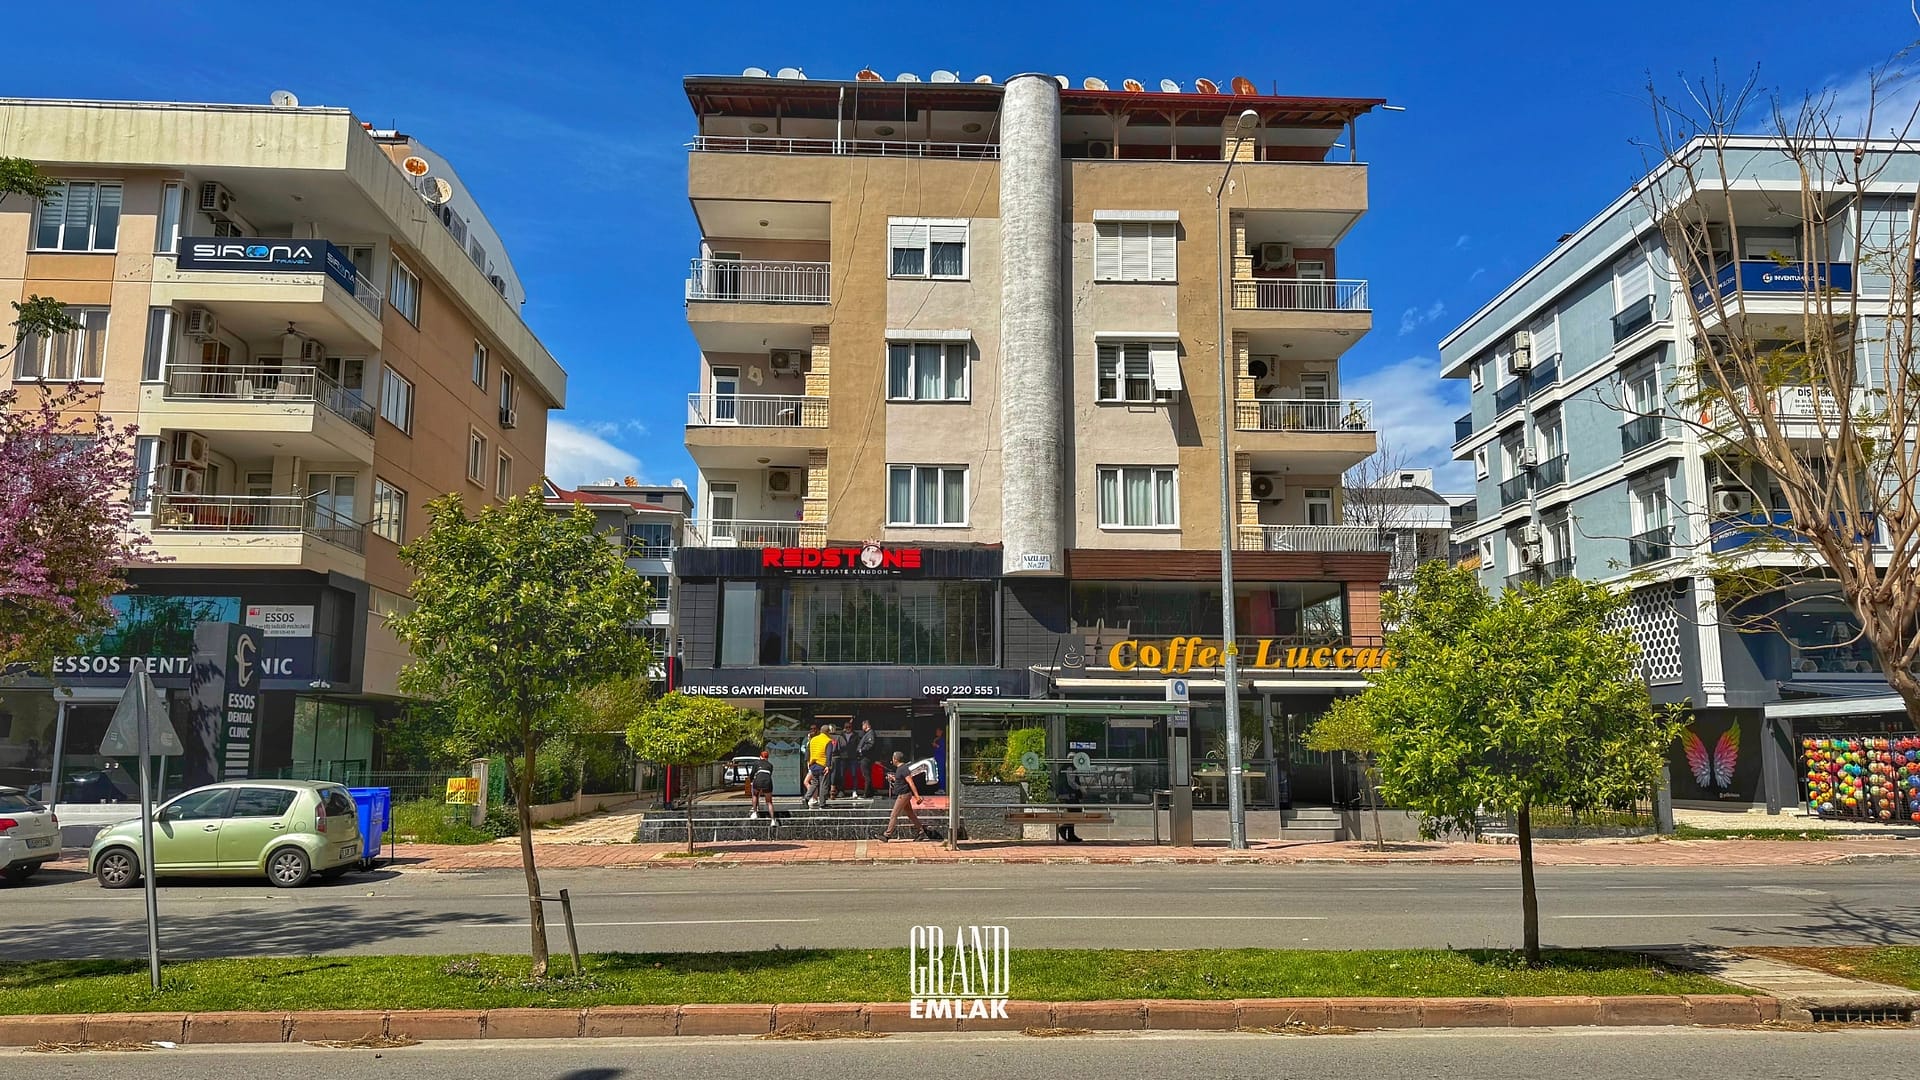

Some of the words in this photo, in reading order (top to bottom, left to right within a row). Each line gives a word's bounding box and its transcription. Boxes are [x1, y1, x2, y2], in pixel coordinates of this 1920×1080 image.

[193, 244, 313, 262] SIRONA
[763, 547, 921, 568] REDSTONE
[265, 612, 295, 623] ESSOS
[52, 656, 120, 674] ESSOS
[129, 656, 192, 674] DENT
[682, 685, 729, 695] USINESS
[731, 683, 809, 695] GAYRİMENKUL
[922, 685, 950, 695] 0850
[952, 685, 972, 695] 220
[974, 685, 993, 695] 555
[228, 693, 255, 709] ESSOS
[227, 711, 253, 724] DENTAL
[228, 726, 250, 738] CLINIC
